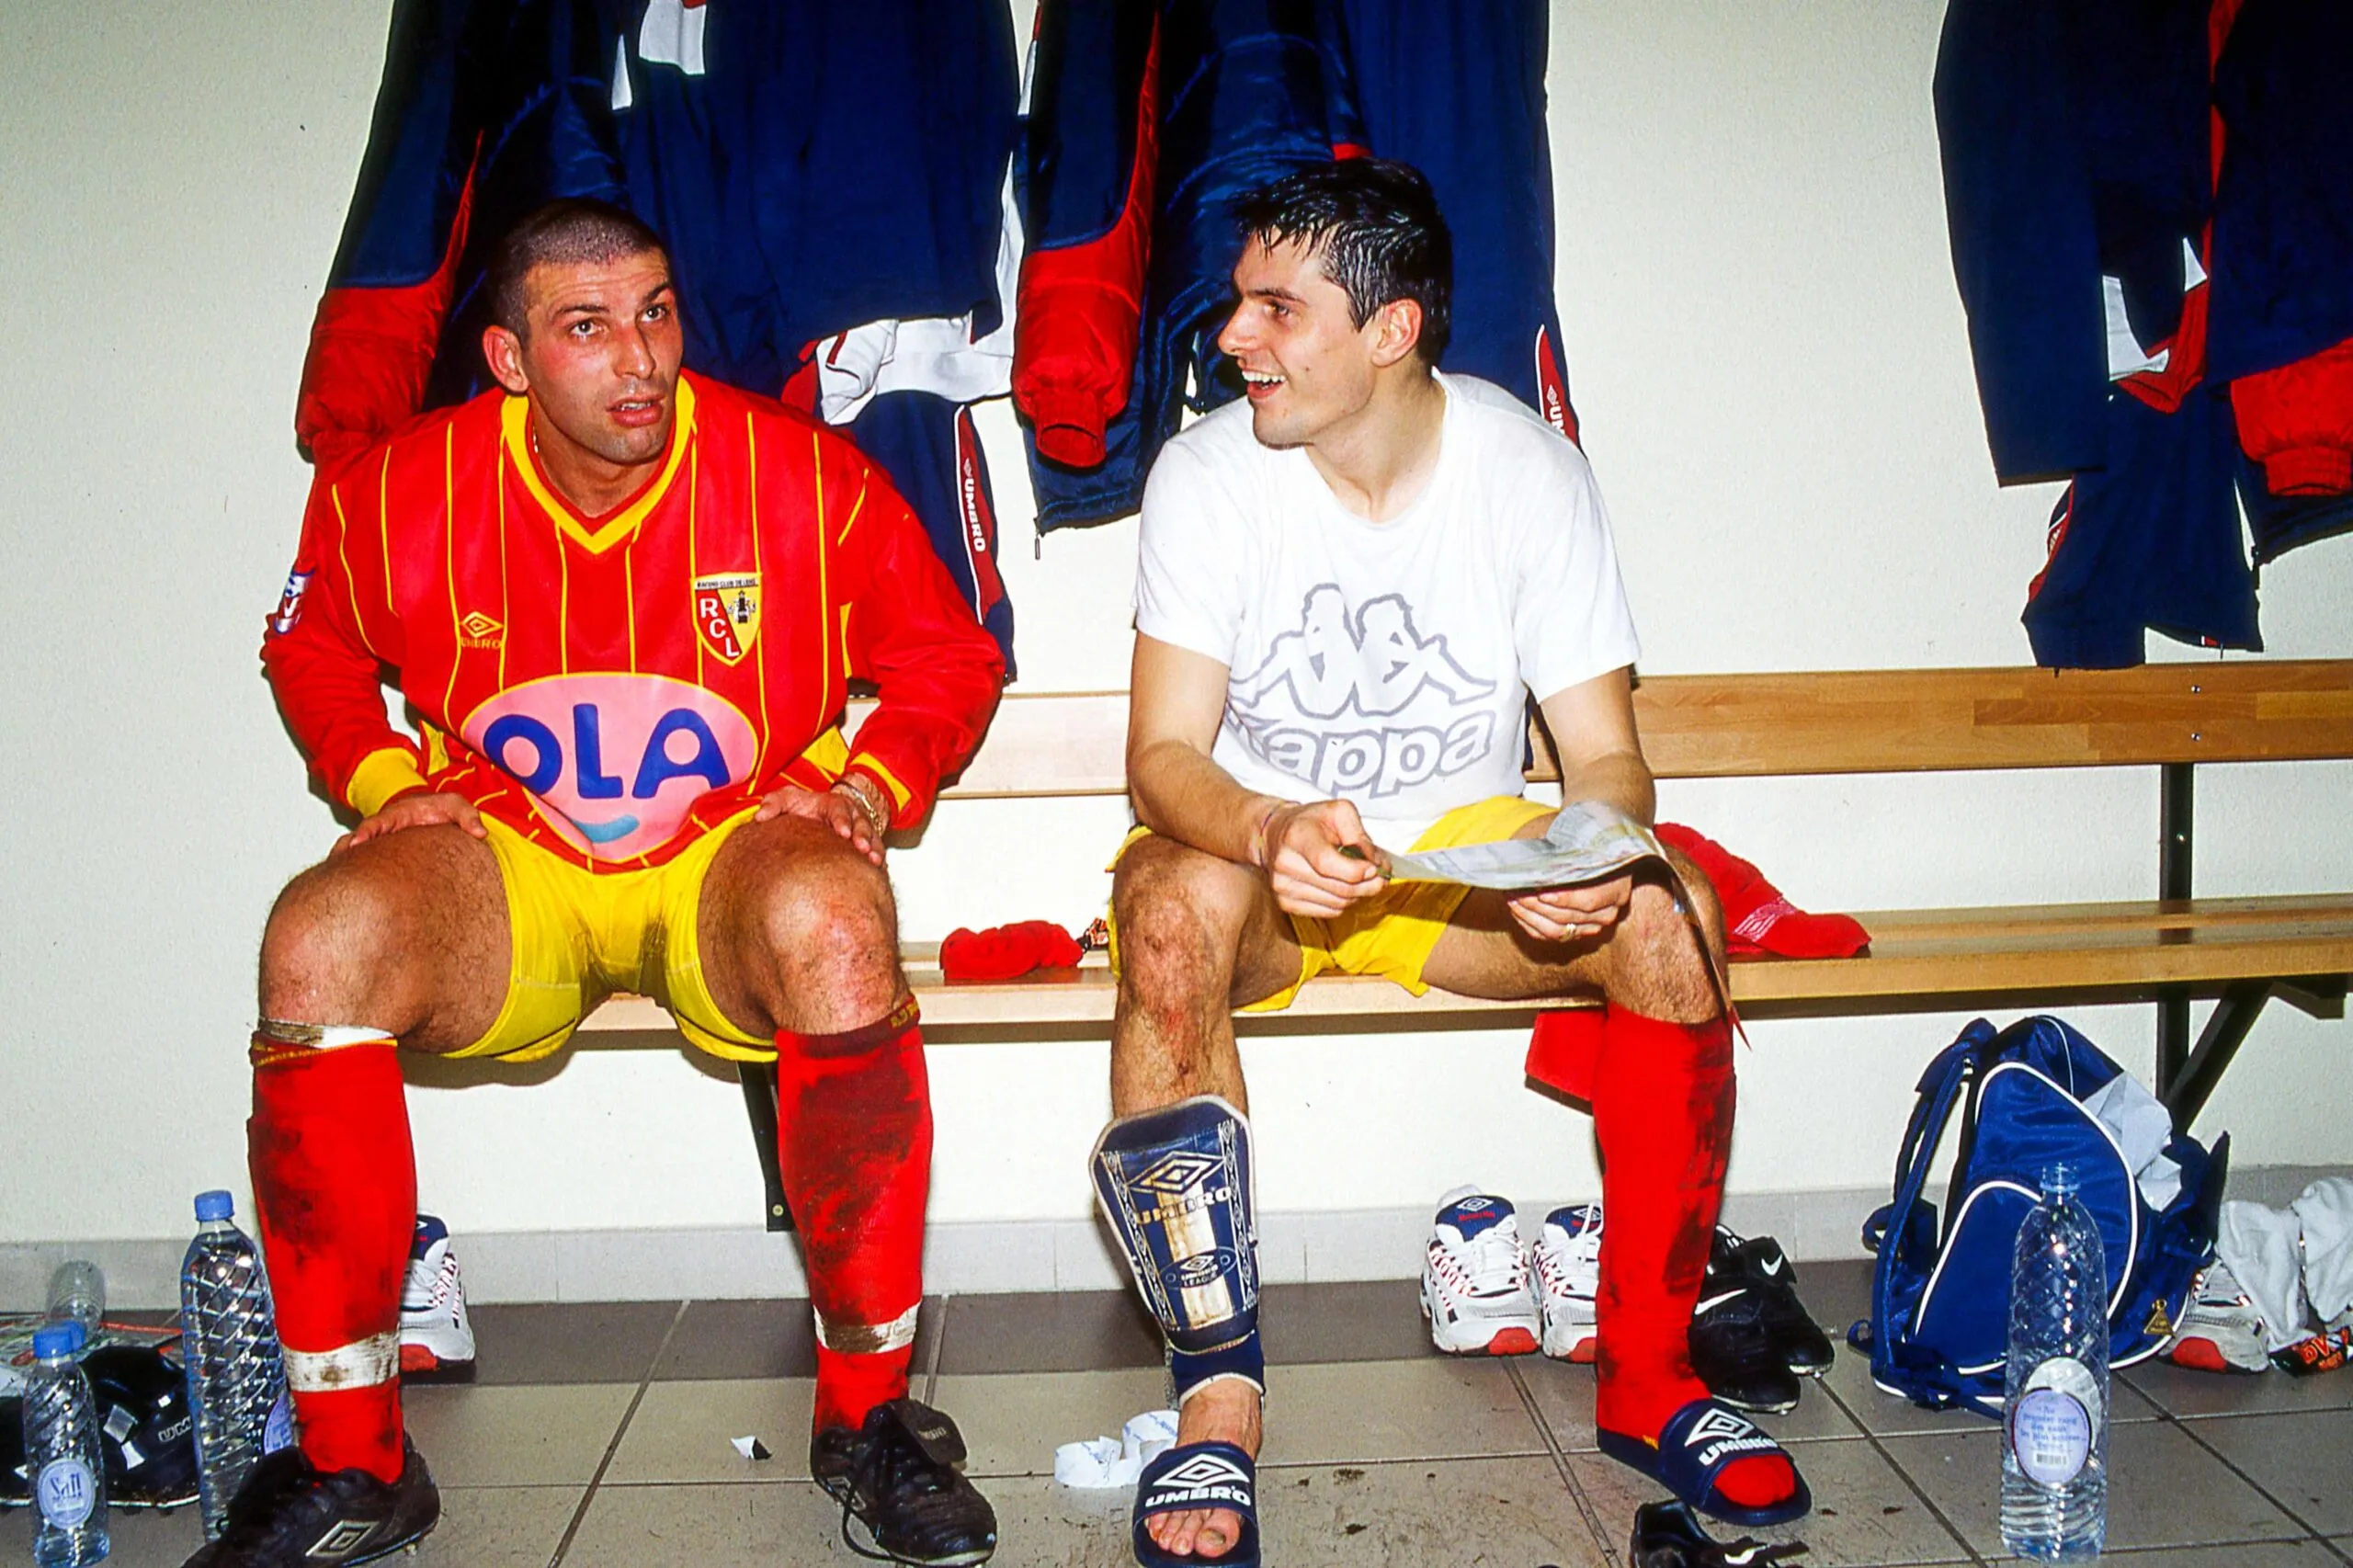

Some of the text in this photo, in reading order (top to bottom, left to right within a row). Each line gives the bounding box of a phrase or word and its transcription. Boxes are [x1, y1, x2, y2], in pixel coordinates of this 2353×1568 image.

[965, 478, 986, 552] UMBRO
[483, 703, 731, 800] OLA
[1135, 1186, 1233, 1224] UMBRO
[1699, 1437, 1779, 1466] UMBRO
[1145, 1485, 1251, 1507] UMBRO
